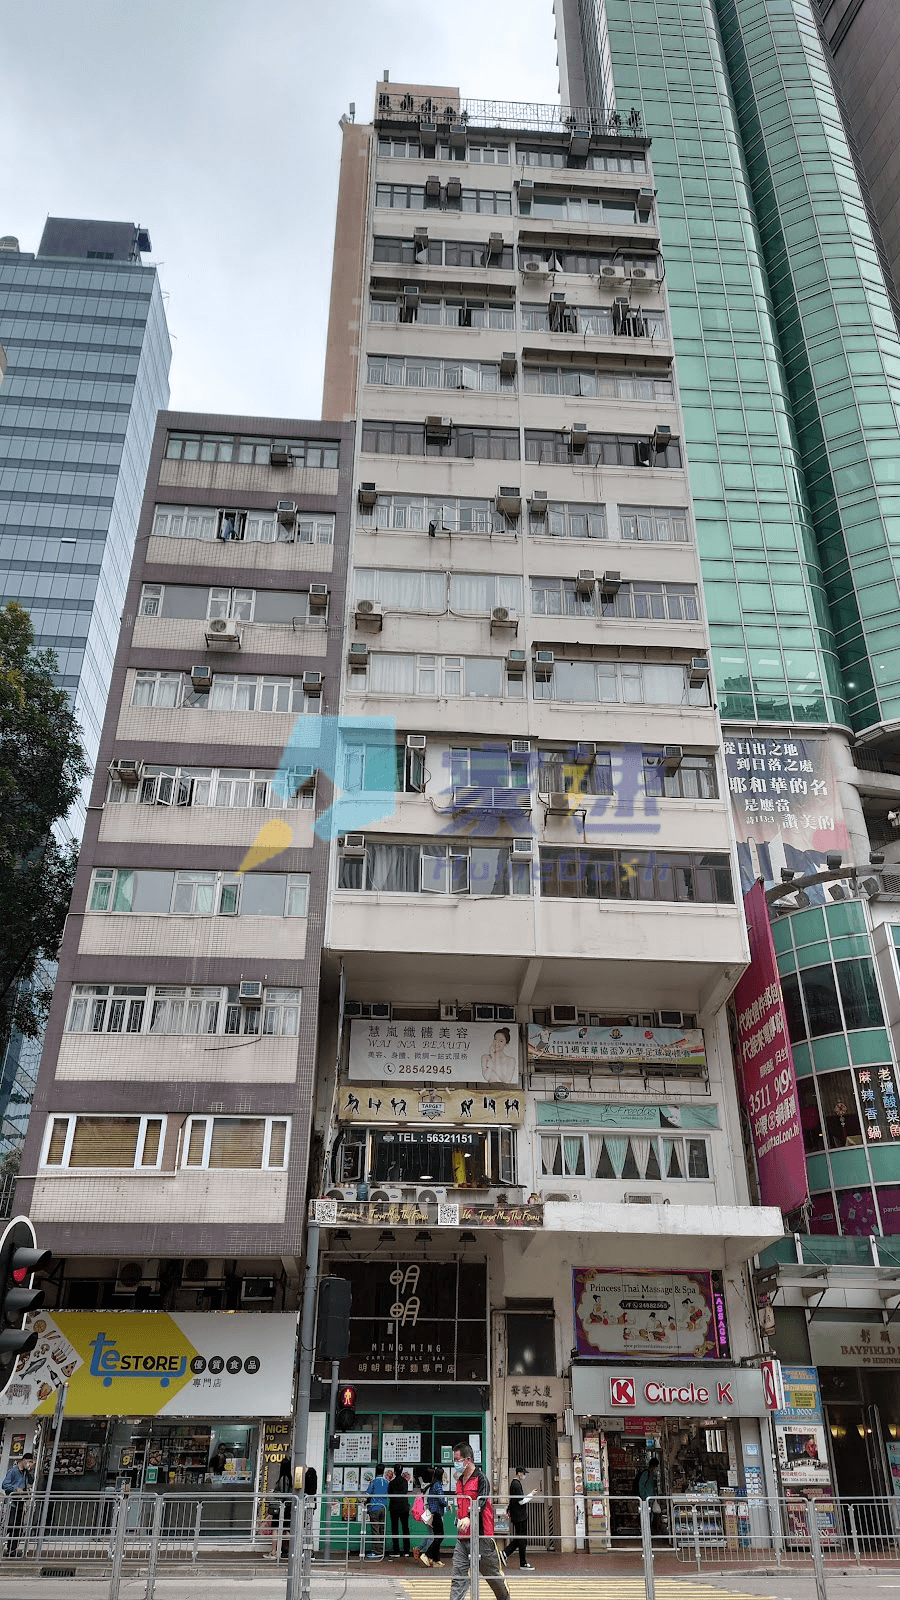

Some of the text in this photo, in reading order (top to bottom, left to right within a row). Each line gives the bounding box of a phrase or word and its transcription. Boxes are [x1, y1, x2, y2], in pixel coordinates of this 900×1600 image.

[723, 741, 799, 756] 從日出之地
[736, 758, 814, 773] 到日落之處
[729, 776, 828, 796] 耶和華的名
[744, 798, 791, 812] 是應當
[781, 813, 835, 831] 讚美的
[367, 1038, 471, 1051] WAI NA BEAUTY
[399, 1064, 452, 1074] 28542945
[858, 1070, 882, 1140] 麻辣香鍋
[878, 1068, 900, 1138] 老壇酸菜魚
[397, 1132, 418, 1142] TEL
[426, 1133, 473, 1143] 56321151
[590, 1284, 621, 1292] Princess
[622, 1284, 640, 1293] Thai
[641, 1285, 673, 1295] Massage
[682, 1286, 696, 1296] Spa
[371, 1343, 441, 1353] MING MING
[840, 1345, 896, 1355] BAYFIELD
[190, 1355, 261, 1375] 優質食品
[644, 1381, 734, 1404] Circle K
[515, 1399, 548, 1408] Warner Bldg
[265, 1424, 288, 1434] NICE
[264, 1443, 289, 1452] MEAT
